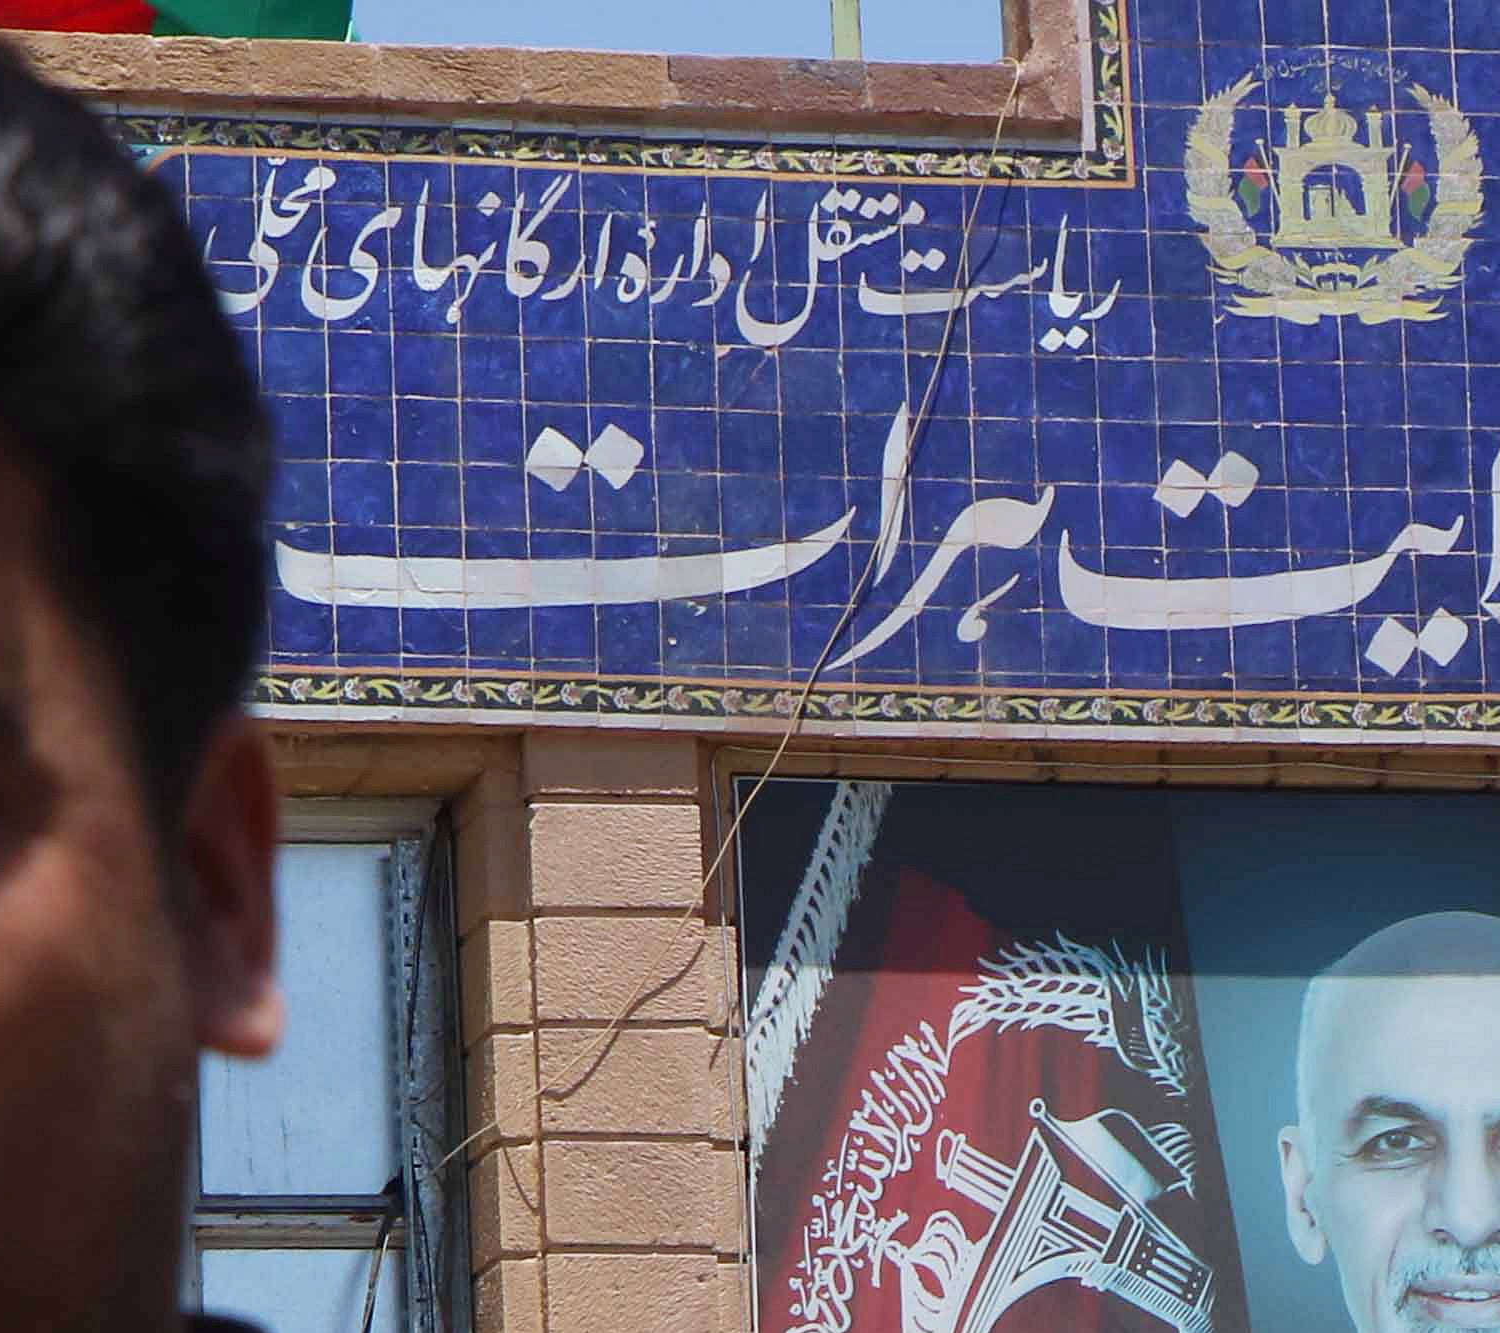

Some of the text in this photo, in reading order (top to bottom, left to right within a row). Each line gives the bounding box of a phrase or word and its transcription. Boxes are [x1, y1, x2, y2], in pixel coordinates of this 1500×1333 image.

[735, 187, 926, 347] مستقل
[858, 214, 1122, 353] ریاست
[274, 400, 1055, 671] هرات
